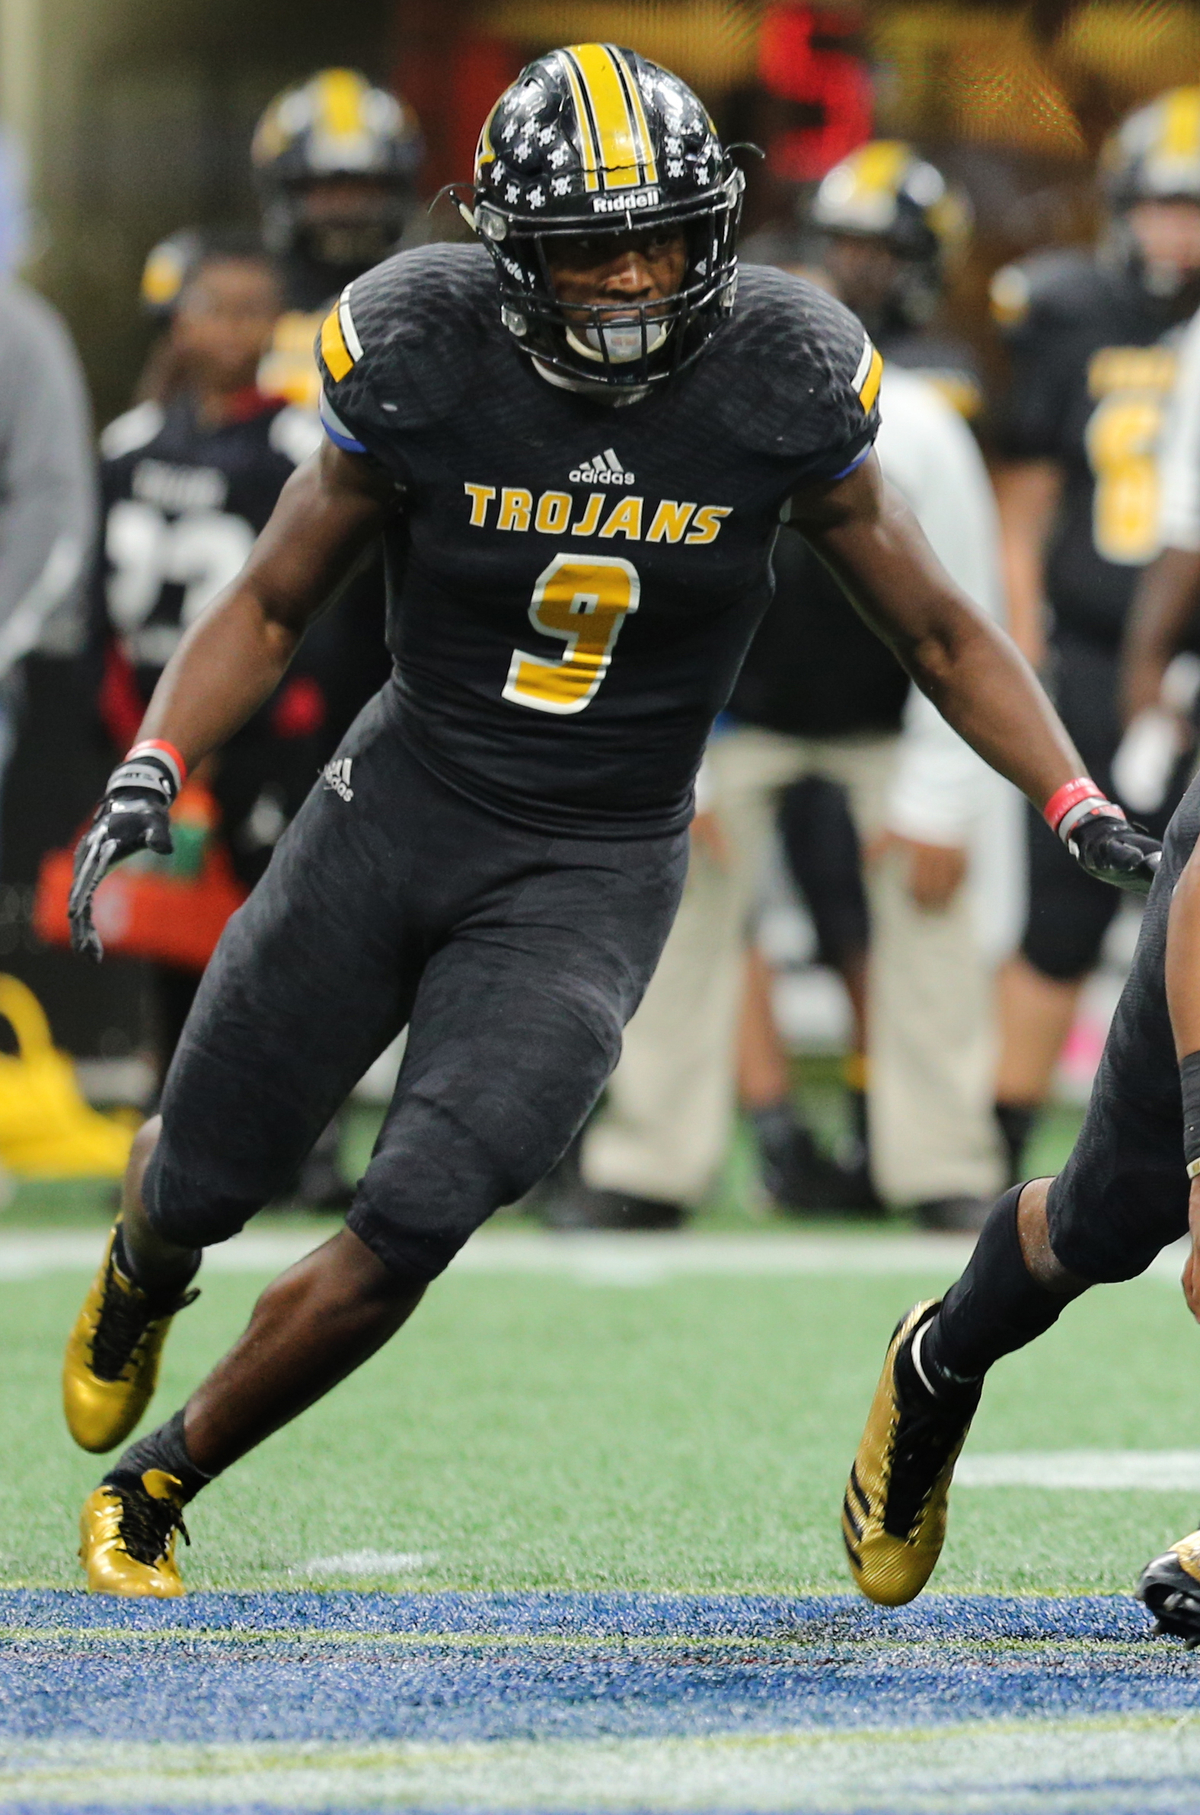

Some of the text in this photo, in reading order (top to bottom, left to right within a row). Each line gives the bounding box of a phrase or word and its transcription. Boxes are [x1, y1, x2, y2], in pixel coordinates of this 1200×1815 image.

[593, 190, 660, 213] Riddell
[568, 468, 636, 485] adidas
[464, 482, 733, 544] TROJANS
[502, 552, 641, 715] 9
